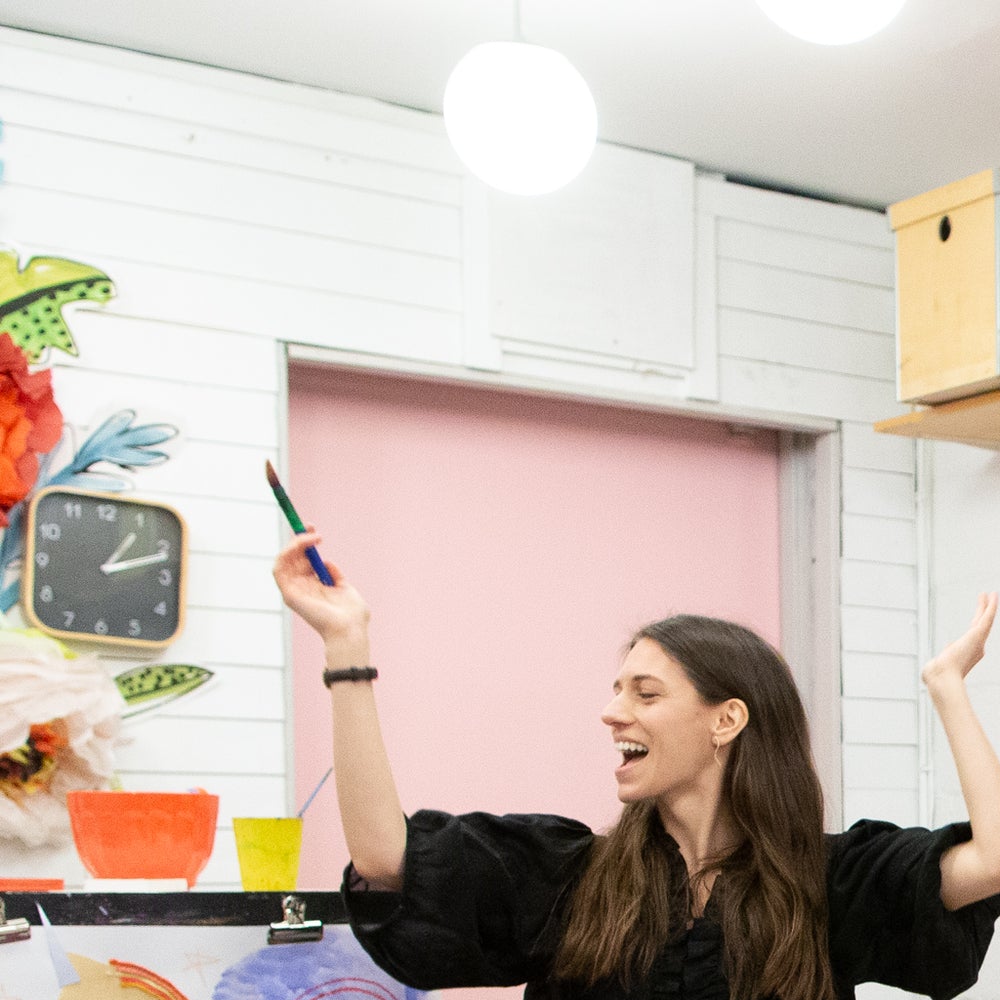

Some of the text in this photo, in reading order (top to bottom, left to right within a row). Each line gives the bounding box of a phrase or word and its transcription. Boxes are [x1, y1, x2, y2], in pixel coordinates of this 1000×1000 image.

[64, 502, 83, 519] 11
[97, 503, 118, 522] 12
[135, 512, 145, 528] 1
[39, 522, 62, 541] 10
[158, 568, 173, 587] 3
[153, 601, 168, 616] 4
[62, 610, 76, 628] 7
